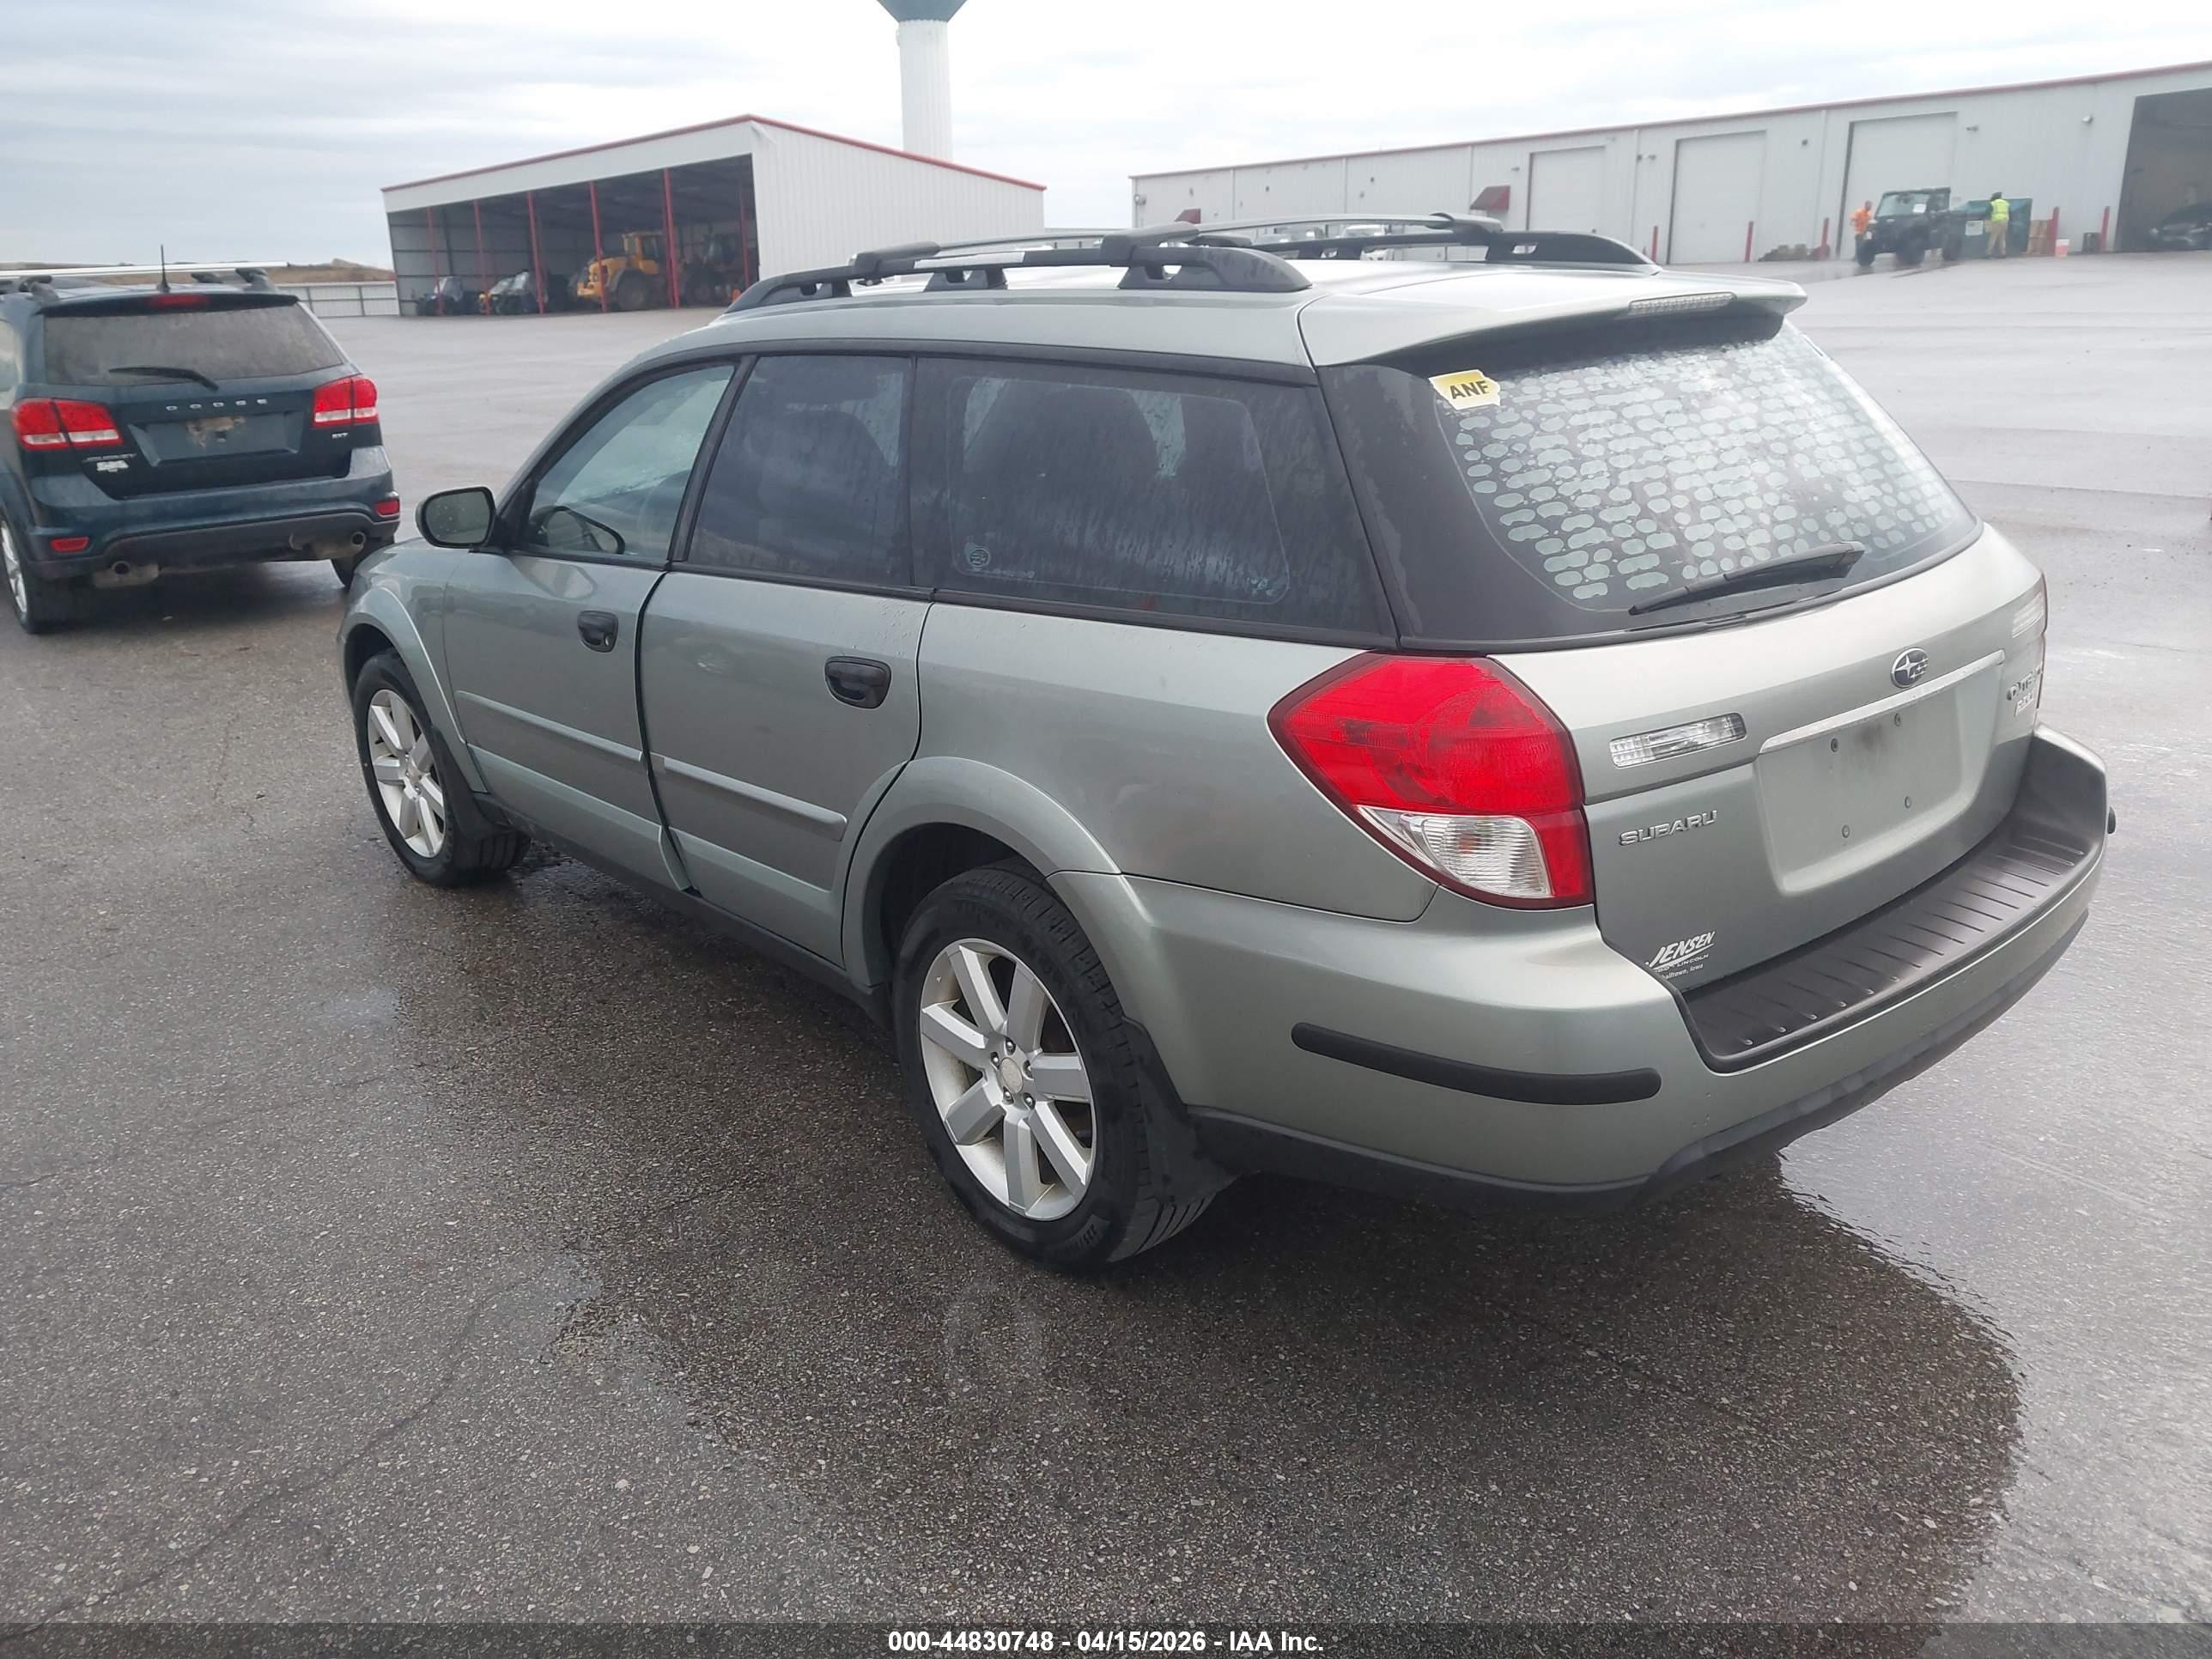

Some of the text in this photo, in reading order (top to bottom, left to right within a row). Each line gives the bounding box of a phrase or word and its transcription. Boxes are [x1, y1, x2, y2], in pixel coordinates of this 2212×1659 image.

[166, 398, 268, 410] DODGE
[1449, 380, 1490, 400] ANF
[1619, 810, 1718, 847] SUBARU
[1645, 931, 1716, 968] JENSEN
